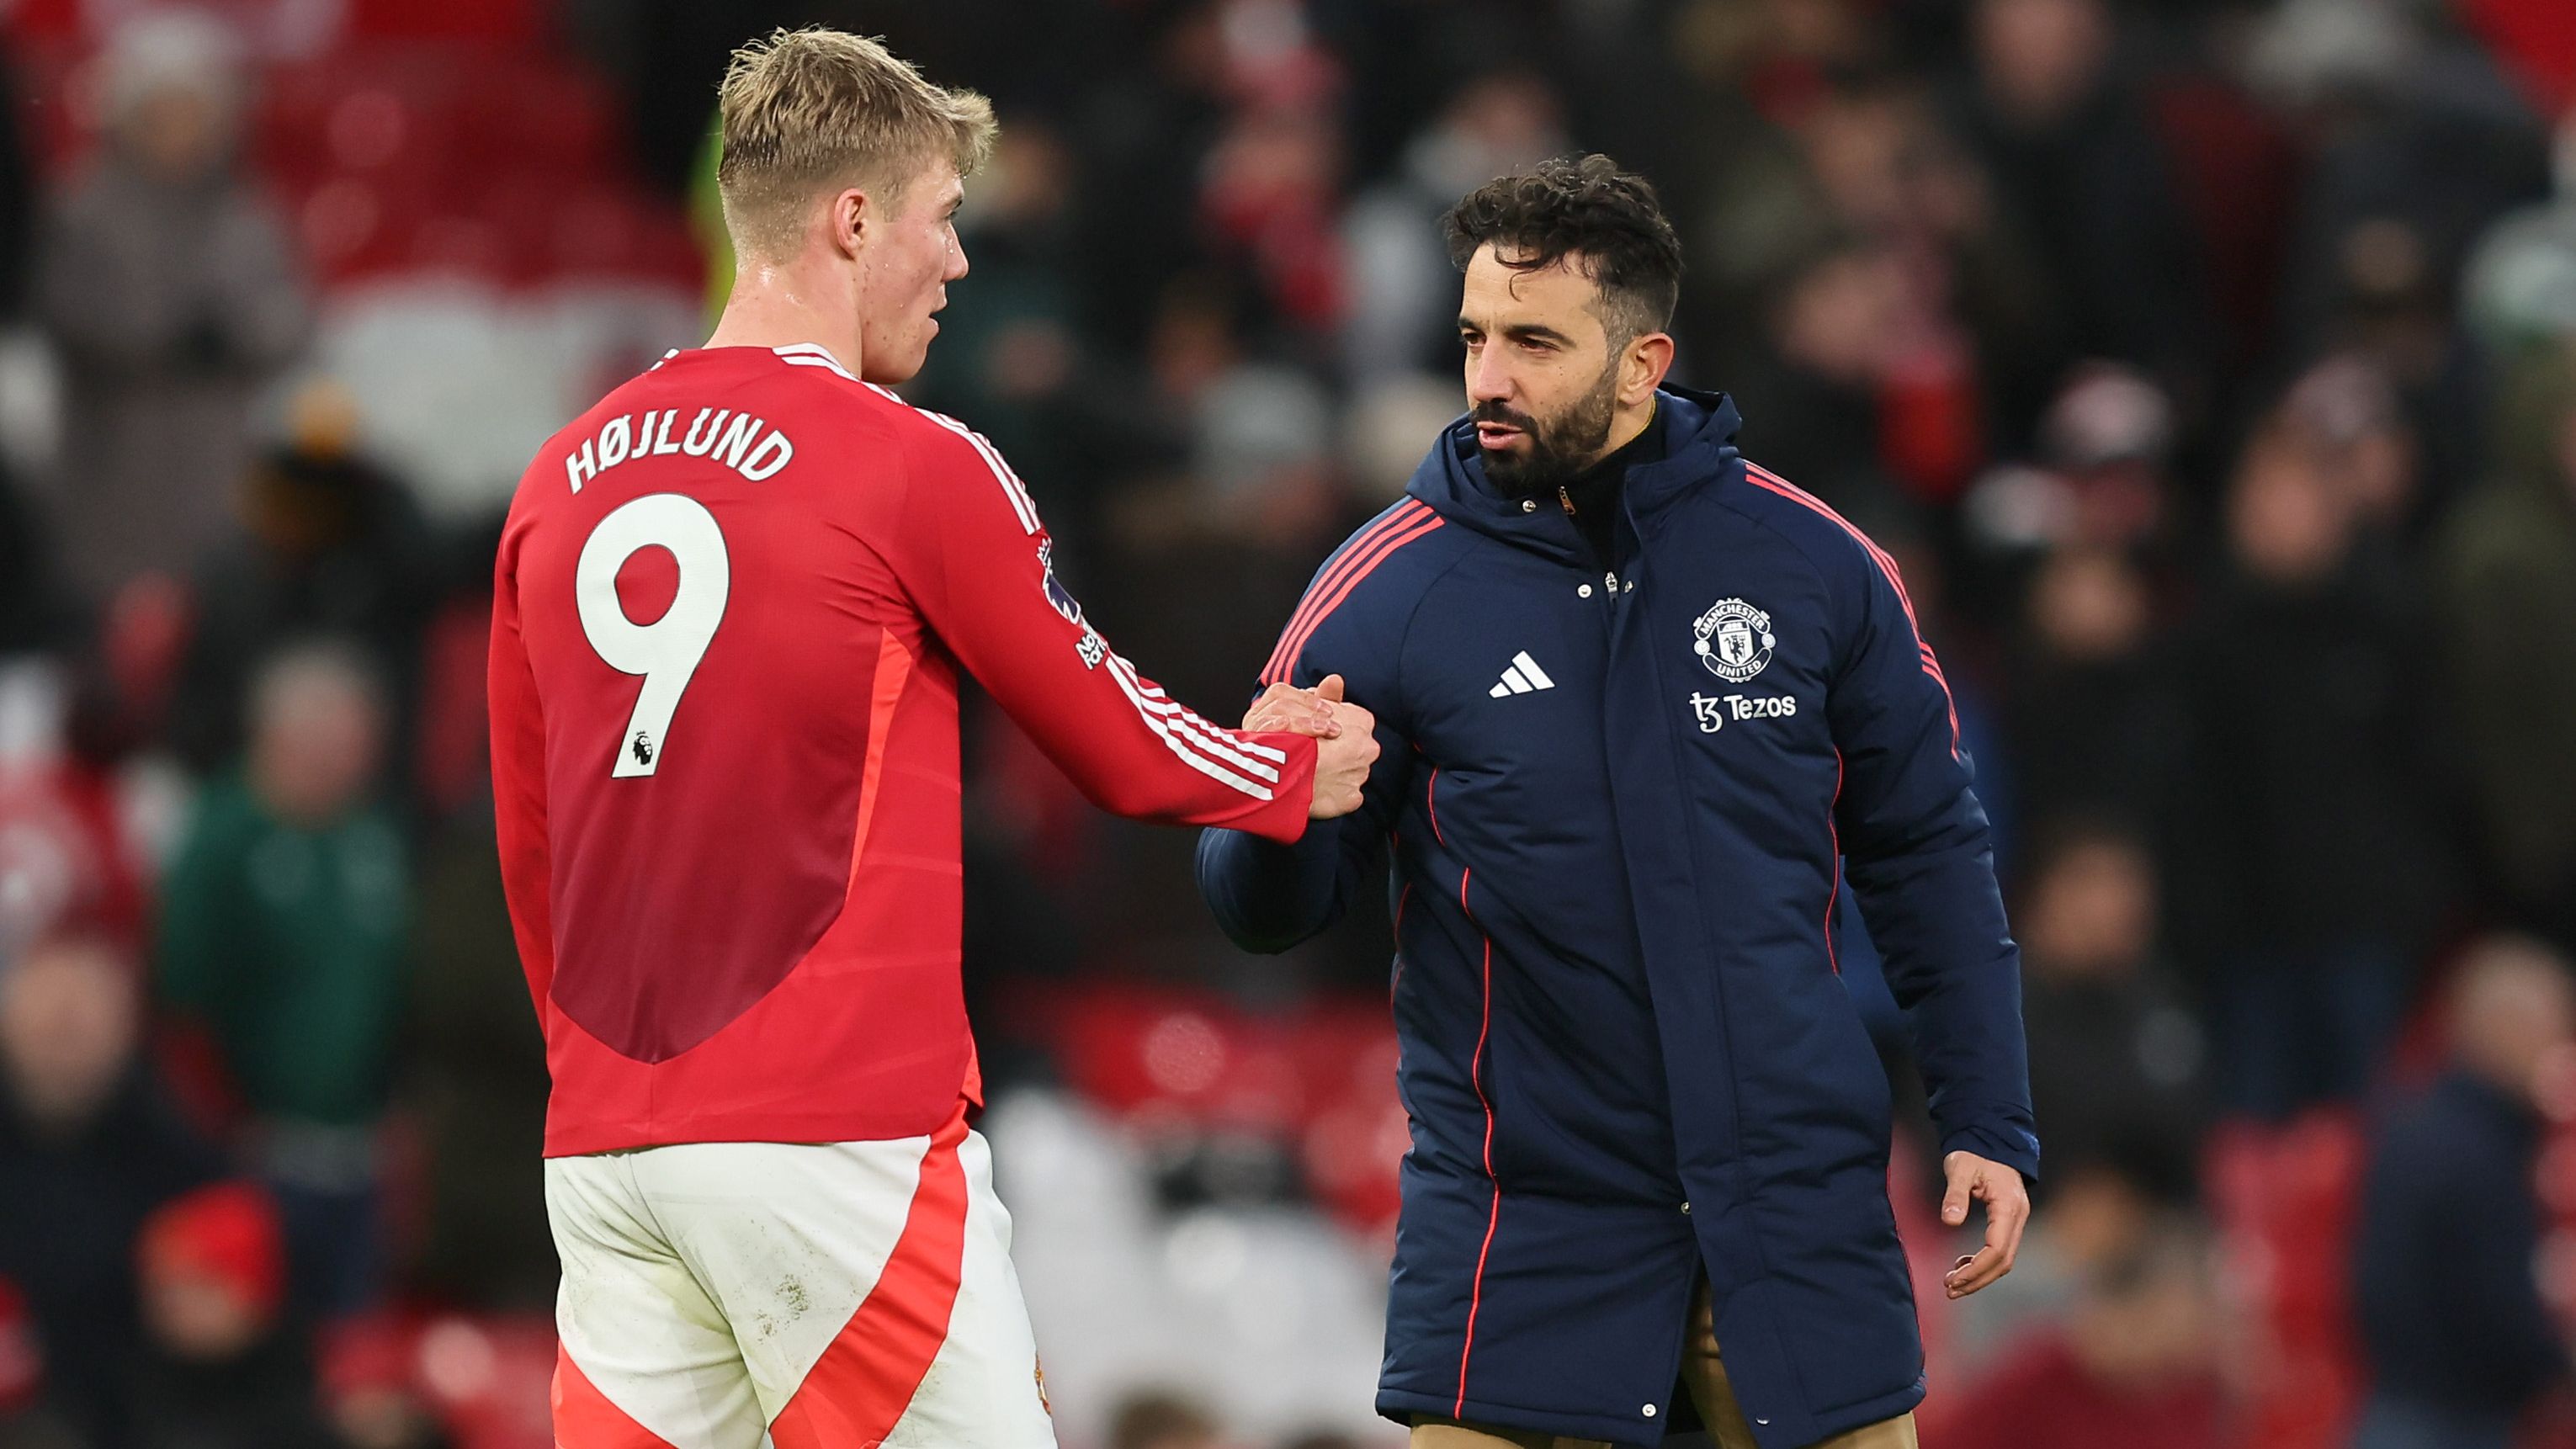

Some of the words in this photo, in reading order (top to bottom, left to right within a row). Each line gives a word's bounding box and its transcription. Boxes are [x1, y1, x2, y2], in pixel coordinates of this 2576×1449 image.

[565, 407, 794, 495] HØJLUND
[1700, 604, 1765, 634] MANCHESTER
[575, 491, 730, 778] 9
[1076, 634, 1096, 660] No
[1717, 660, 1761, 677] UNITED
[1724, 695, 1796, 720] Tezos
